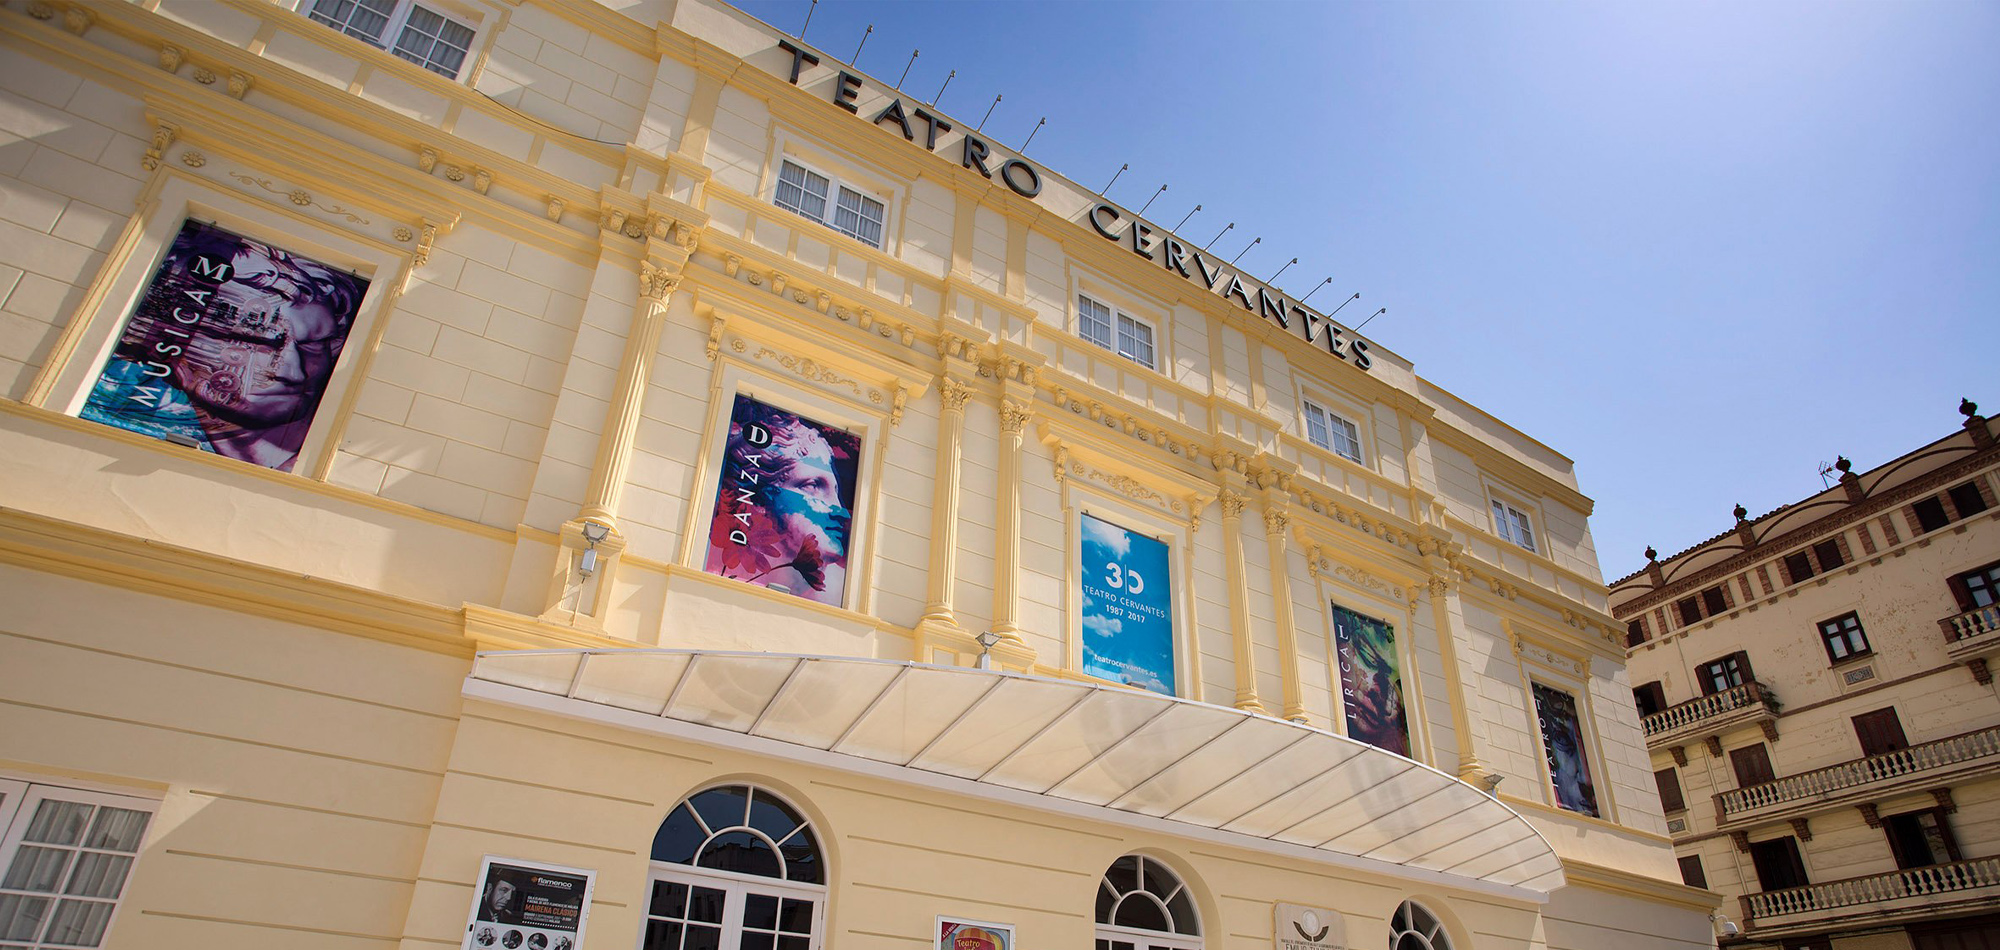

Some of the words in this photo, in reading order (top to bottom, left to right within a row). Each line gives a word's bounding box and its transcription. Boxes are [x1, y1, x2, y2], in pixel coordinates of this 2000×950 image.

[778, 39, 1043, 198] TEATRO
[1089, 203, 1373, 370] CERVANTES
[190, 255, 231, 283] M
[128, 290, 212, 408] MÚSICA
[749, 424, 768, 445] D
[729, 454, 762, 546] DANZA
[1084, 585, 1117, 602] TEATRO
[1120, 597, 1165, 618] CERVANTES
[1105, 604, 1124, 616] 1987
[1127, 611, 1146, 623] 2017
[1338, 624, 1349, 640] L
[1094, 653, 1158, 678] teatrocervantes.es
[1339, 647, 1357, 719] LÍRICA
[537, 877, 573, 888] flamenco
[525, 903, 552, 914] MAIRENA
[957, 939, 980, 948] Teatro
